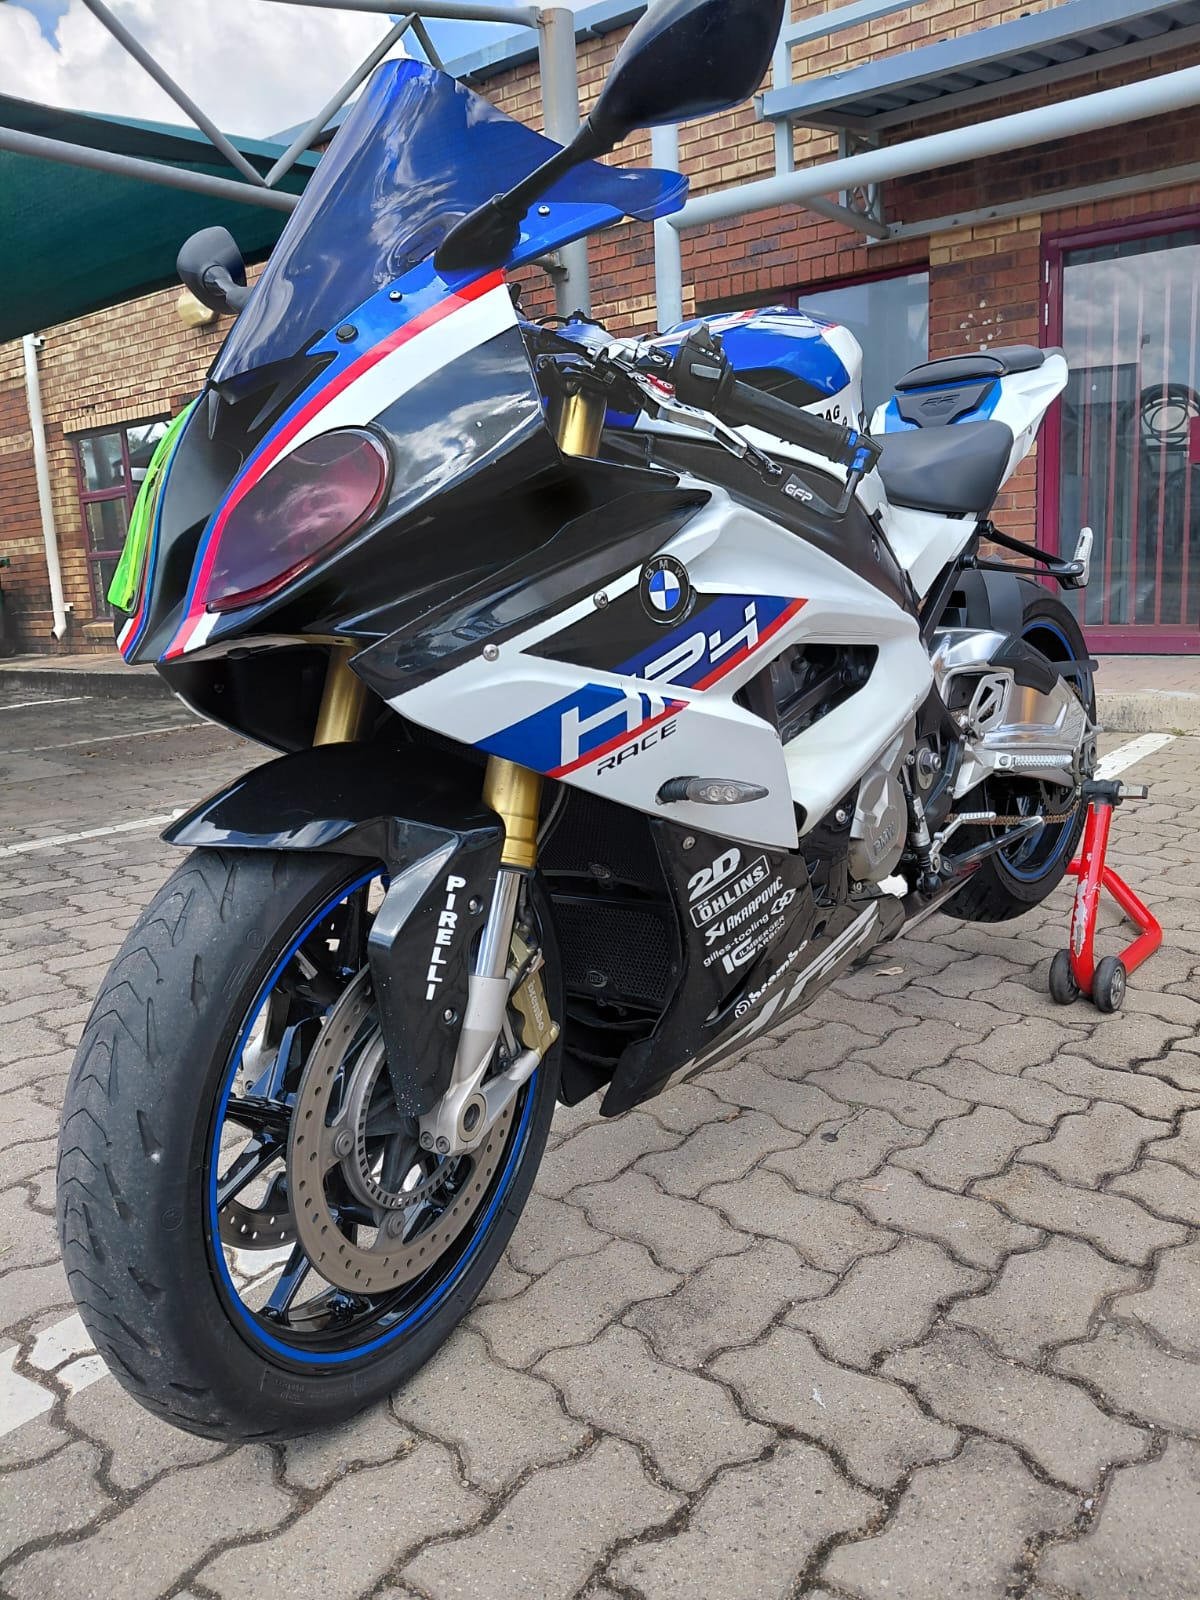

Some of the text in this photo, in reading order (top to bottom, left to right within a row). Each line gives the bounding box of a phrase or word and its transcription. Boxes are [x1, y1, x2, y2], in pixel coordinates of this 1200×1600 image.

[784, 483, 814, 502] GFP
[645, 560, 684, 580] BMW
[561, 601, 759, 767] HP4
[597, 720, 677, 776] RACE
[687, 848, 740, 902] 2D
[697, 866, 765, 921] ÖHLINS
[425, 875, 466, 1000] PIRELLI
[703, 913, 769, 967] gilles-tooling
[748, 940, 808, 1004] brembo
[527, 979, 545, 1031] brembo
